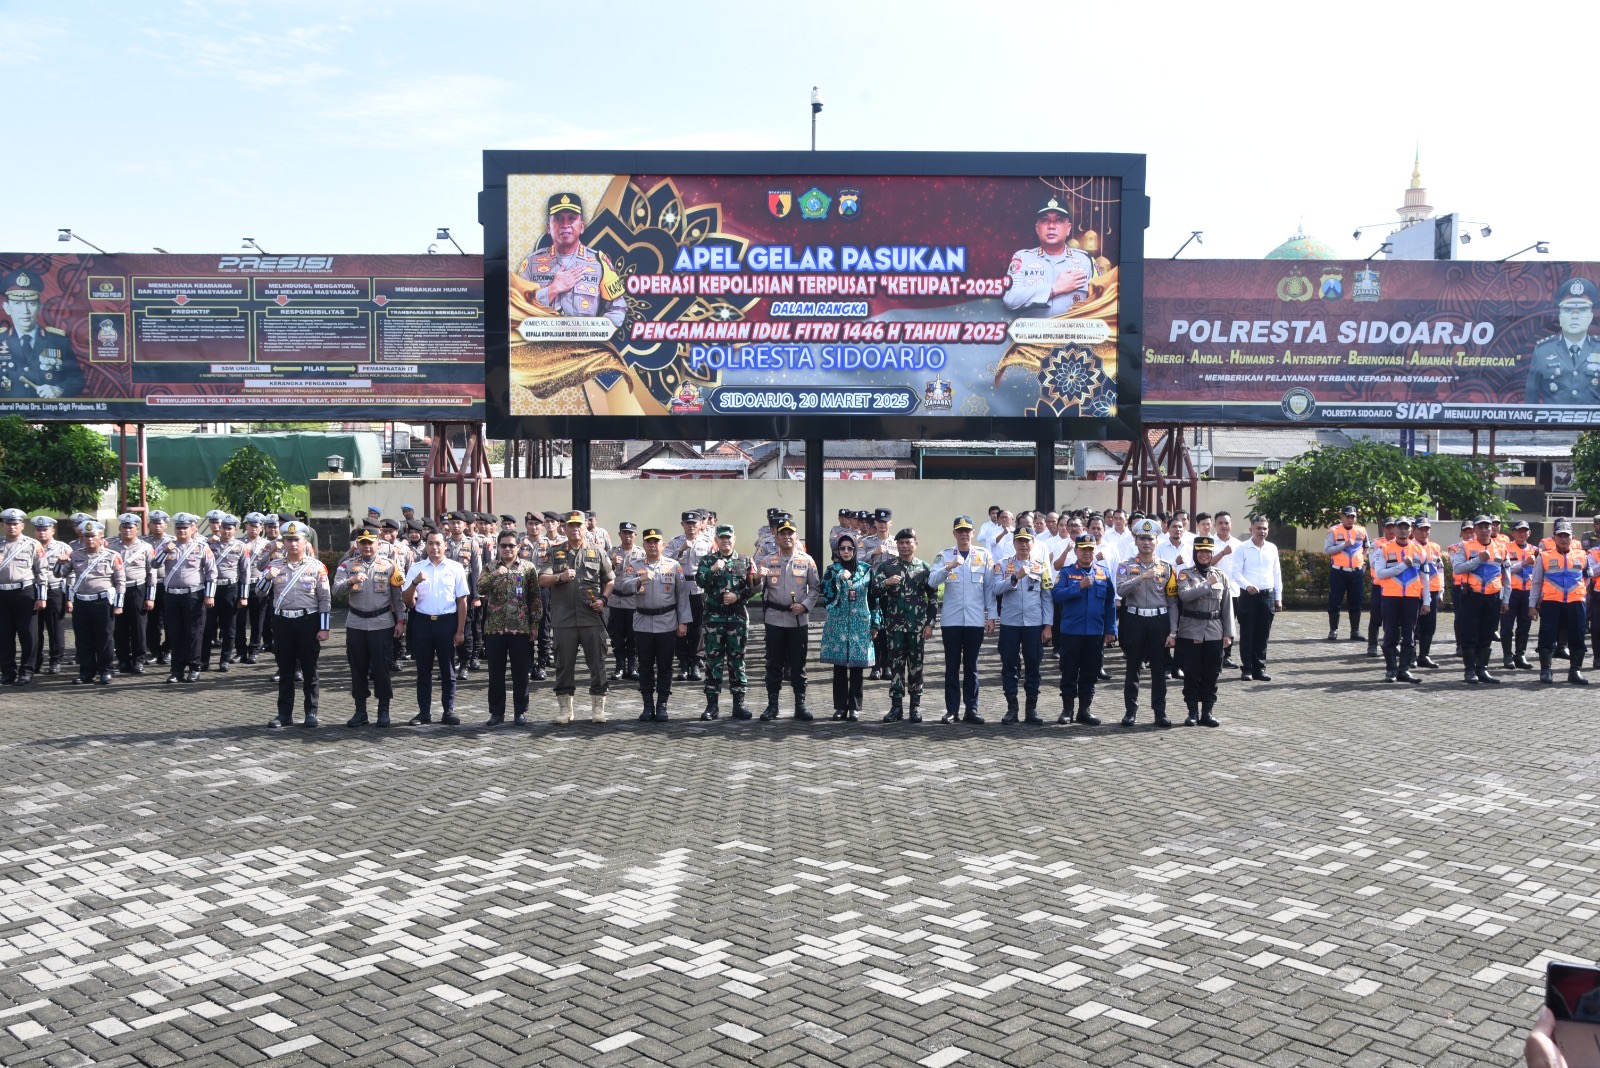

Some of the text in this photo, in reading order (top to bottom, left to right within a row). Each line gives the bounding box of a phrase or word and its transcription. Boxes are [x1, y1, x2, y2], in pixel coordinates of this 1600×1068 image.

[218, 256, 334, 269] PRESISI
[674, 246, 966, 271] APEL GELAR PASUKAN
[627, 275, 696, 294] OPERASI
[698, 275, 795, 294] KEPOLISIAN
[797, 276, 877, 295] TERPUSAT
[771, 302, 868, 317] DALAM RANGKA
[631, 322, 1007, 341] PENGAMANAN IDUL FITRI 1446 H TAHUN 2025
[1168, 320, 1495, 344] POLRESTA SIDOARJO
[691, 346, 947, 371] POLRESTA SIDOARJO
[43, 403, 58, 411] Listyo
[59, 403, 71, 412] Sigit
[72, 403, 95, 411] Prabowo,
[719, 392, 910, 409] SIDOARJO, 20 MARET 2025
[1357, 409, 1392, 418] SIDOARJO
[1396, 402, 1442, 419] SIAP
[1444, 410, 1480, 418] MENUJU
[1481, 410, 1506, 419] POLRI
[1508, 410, 1533, 420] YANG
[1534, 411, 1600, 422] PRESIS
